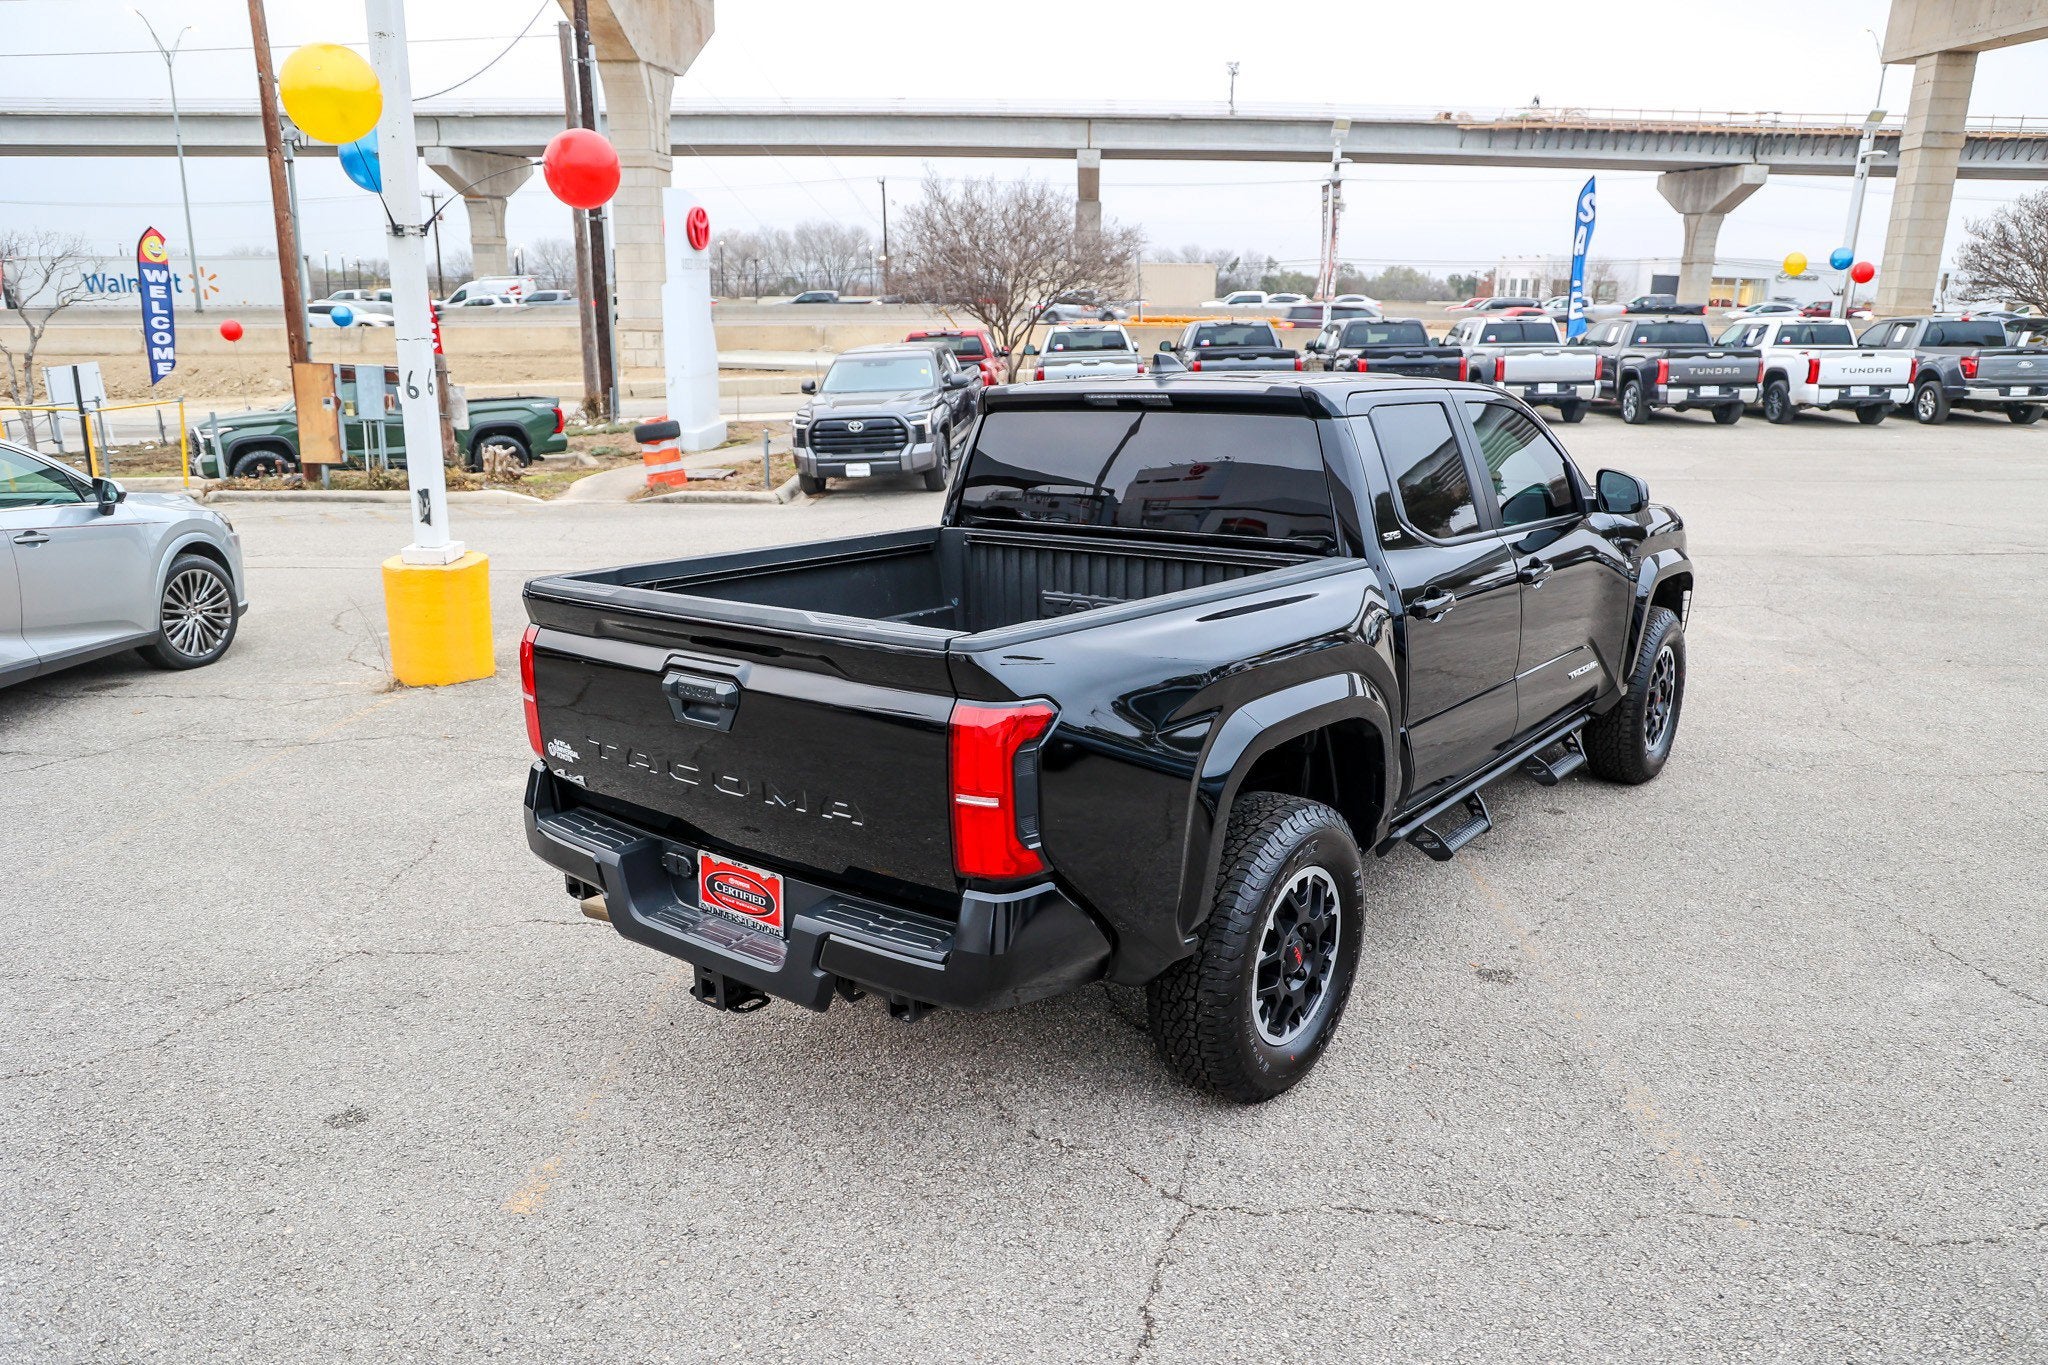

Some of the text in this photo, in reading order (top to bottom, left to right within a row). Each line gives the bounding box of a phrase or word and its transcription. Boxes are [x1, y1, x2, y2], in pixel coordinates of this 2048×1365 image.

[142, 268, 174, 376] WELCOME
[1688, 367, 1742, 375] TUNDRA
[1567, 660, 1599, 680] TACOMA
[586, 735, 864, 826] TACOMA
